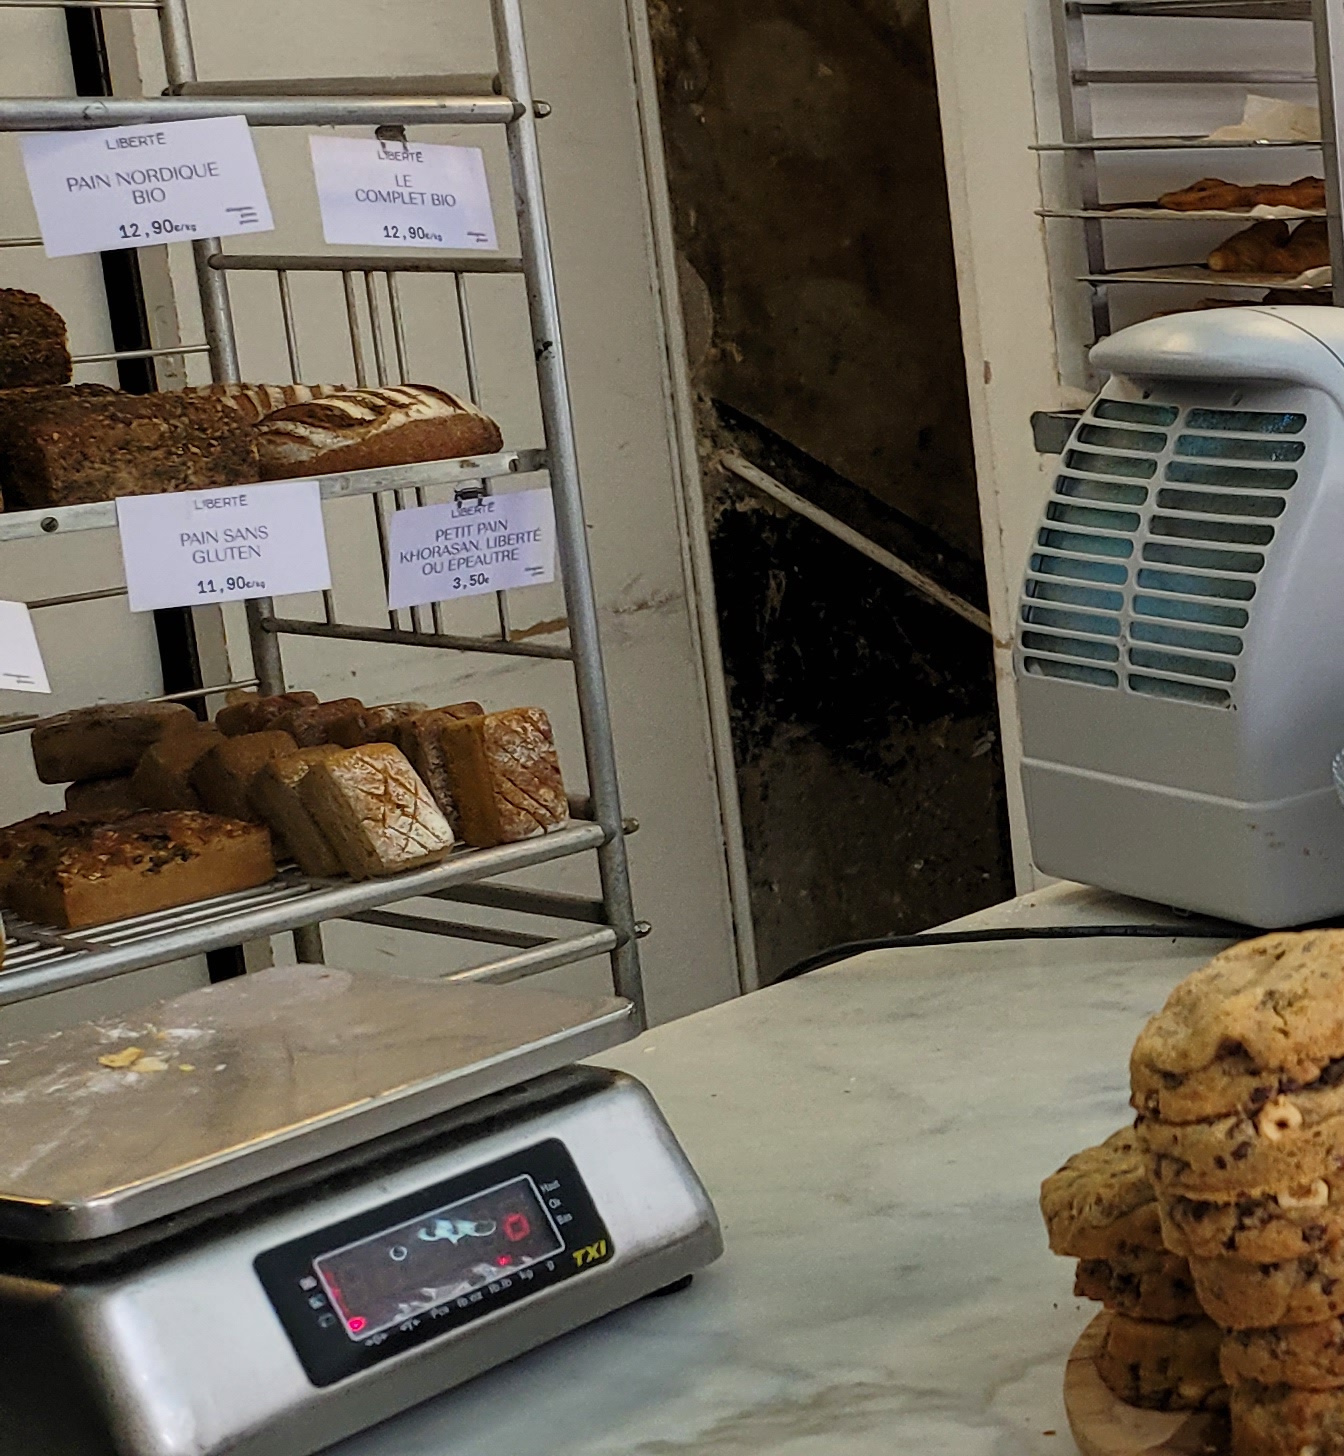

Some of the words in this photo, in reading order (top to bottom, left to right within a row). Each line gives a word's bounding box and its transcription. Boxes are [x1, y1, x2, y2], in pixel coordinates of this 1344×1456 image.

[66, 173, 111, 192] PAIN
[116, 162, 220, 187] NORDIQUE
[395, 174, 413, 188] LE
[132, 187, 166, 205] BIO
[355, 188, 427, 206] COMPLET
[431, 193, 457, 207] BIO
[179, 531, 220, 547] PAIN
[223, 525, 269, 542] SANS
[435, 525, 474, 542] PETIT
[477, 519, 508, 536] PAIN
[486, 527, 542, 549] LIBERTÉ
[191, 545, 262, 564] GLUTEN
[422, 562, 444, 576] OU
[452, 572, 490, 590] 3,50€
[572, 1239, 608, 1268] TXI
